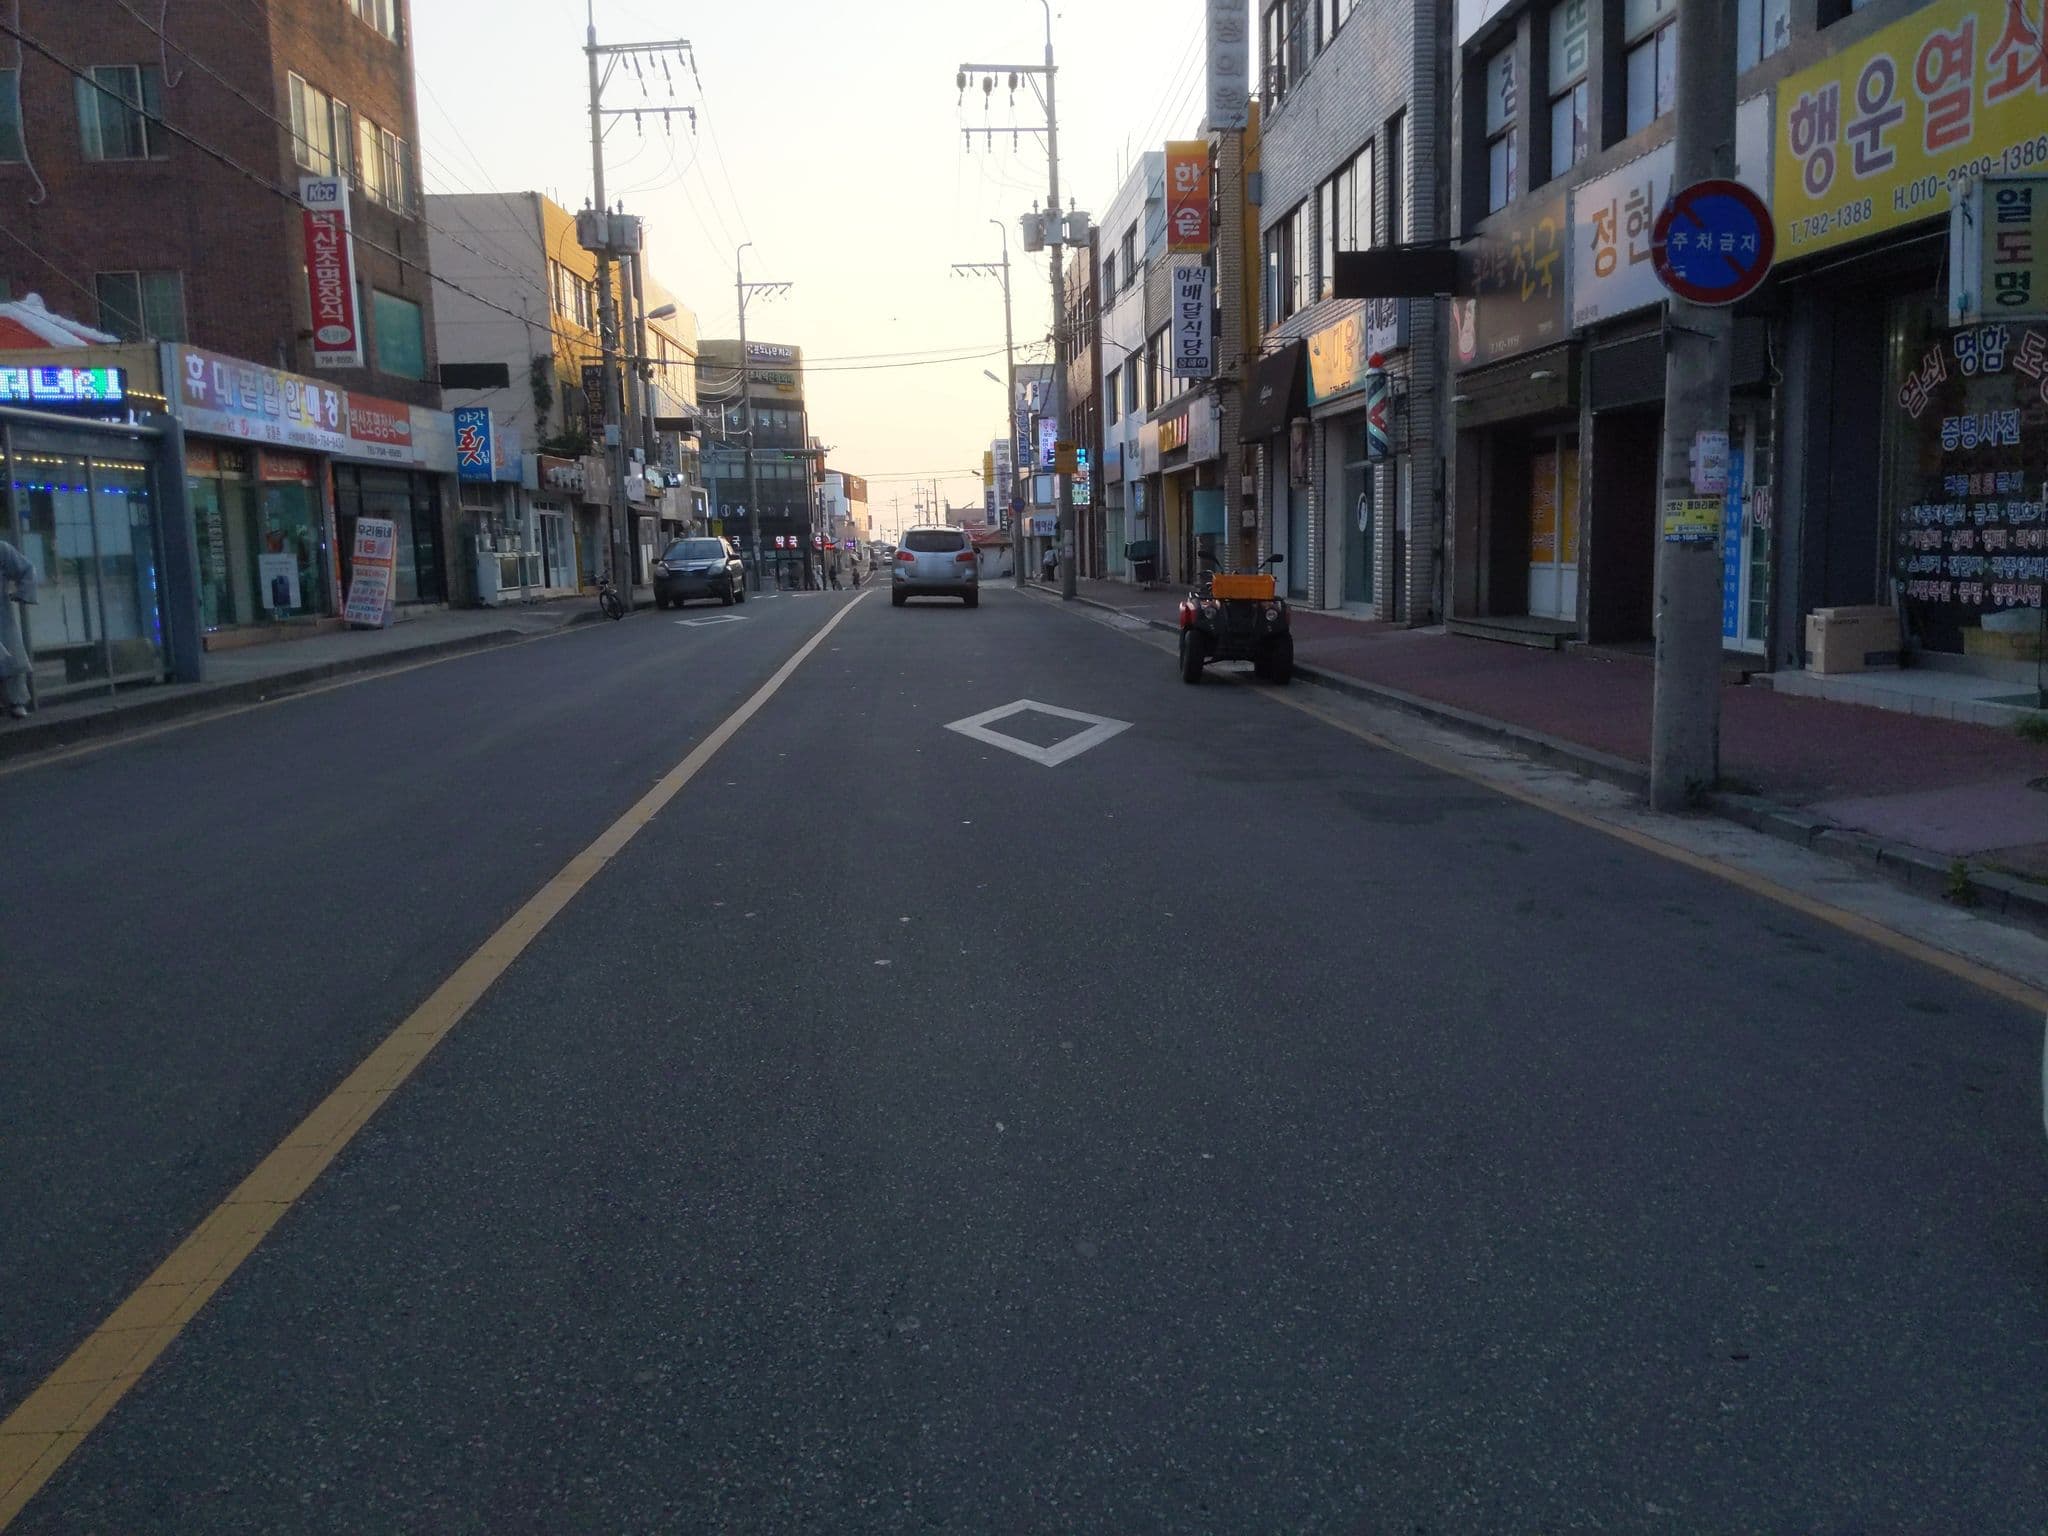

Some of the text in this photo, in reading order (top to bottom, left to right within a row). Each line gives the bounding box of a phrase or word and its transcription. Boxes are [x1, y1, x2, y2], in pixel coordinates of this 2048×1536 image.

[308, 186, 335, 200] KCC
[1672, 231, 1756, 253] 주차금지
[1177, 269, 1207, 283] 야식
[1182, 284, 1204, 357] 배달식당
[1898, 344, 1948, 419] 열쇠
[1953, 325, 2010, 376] 명함
[458, 411, 486, 426] 야간
[1941, 408, 2021, 451] 증명사진
[775, 535, 799, 549] 약국
